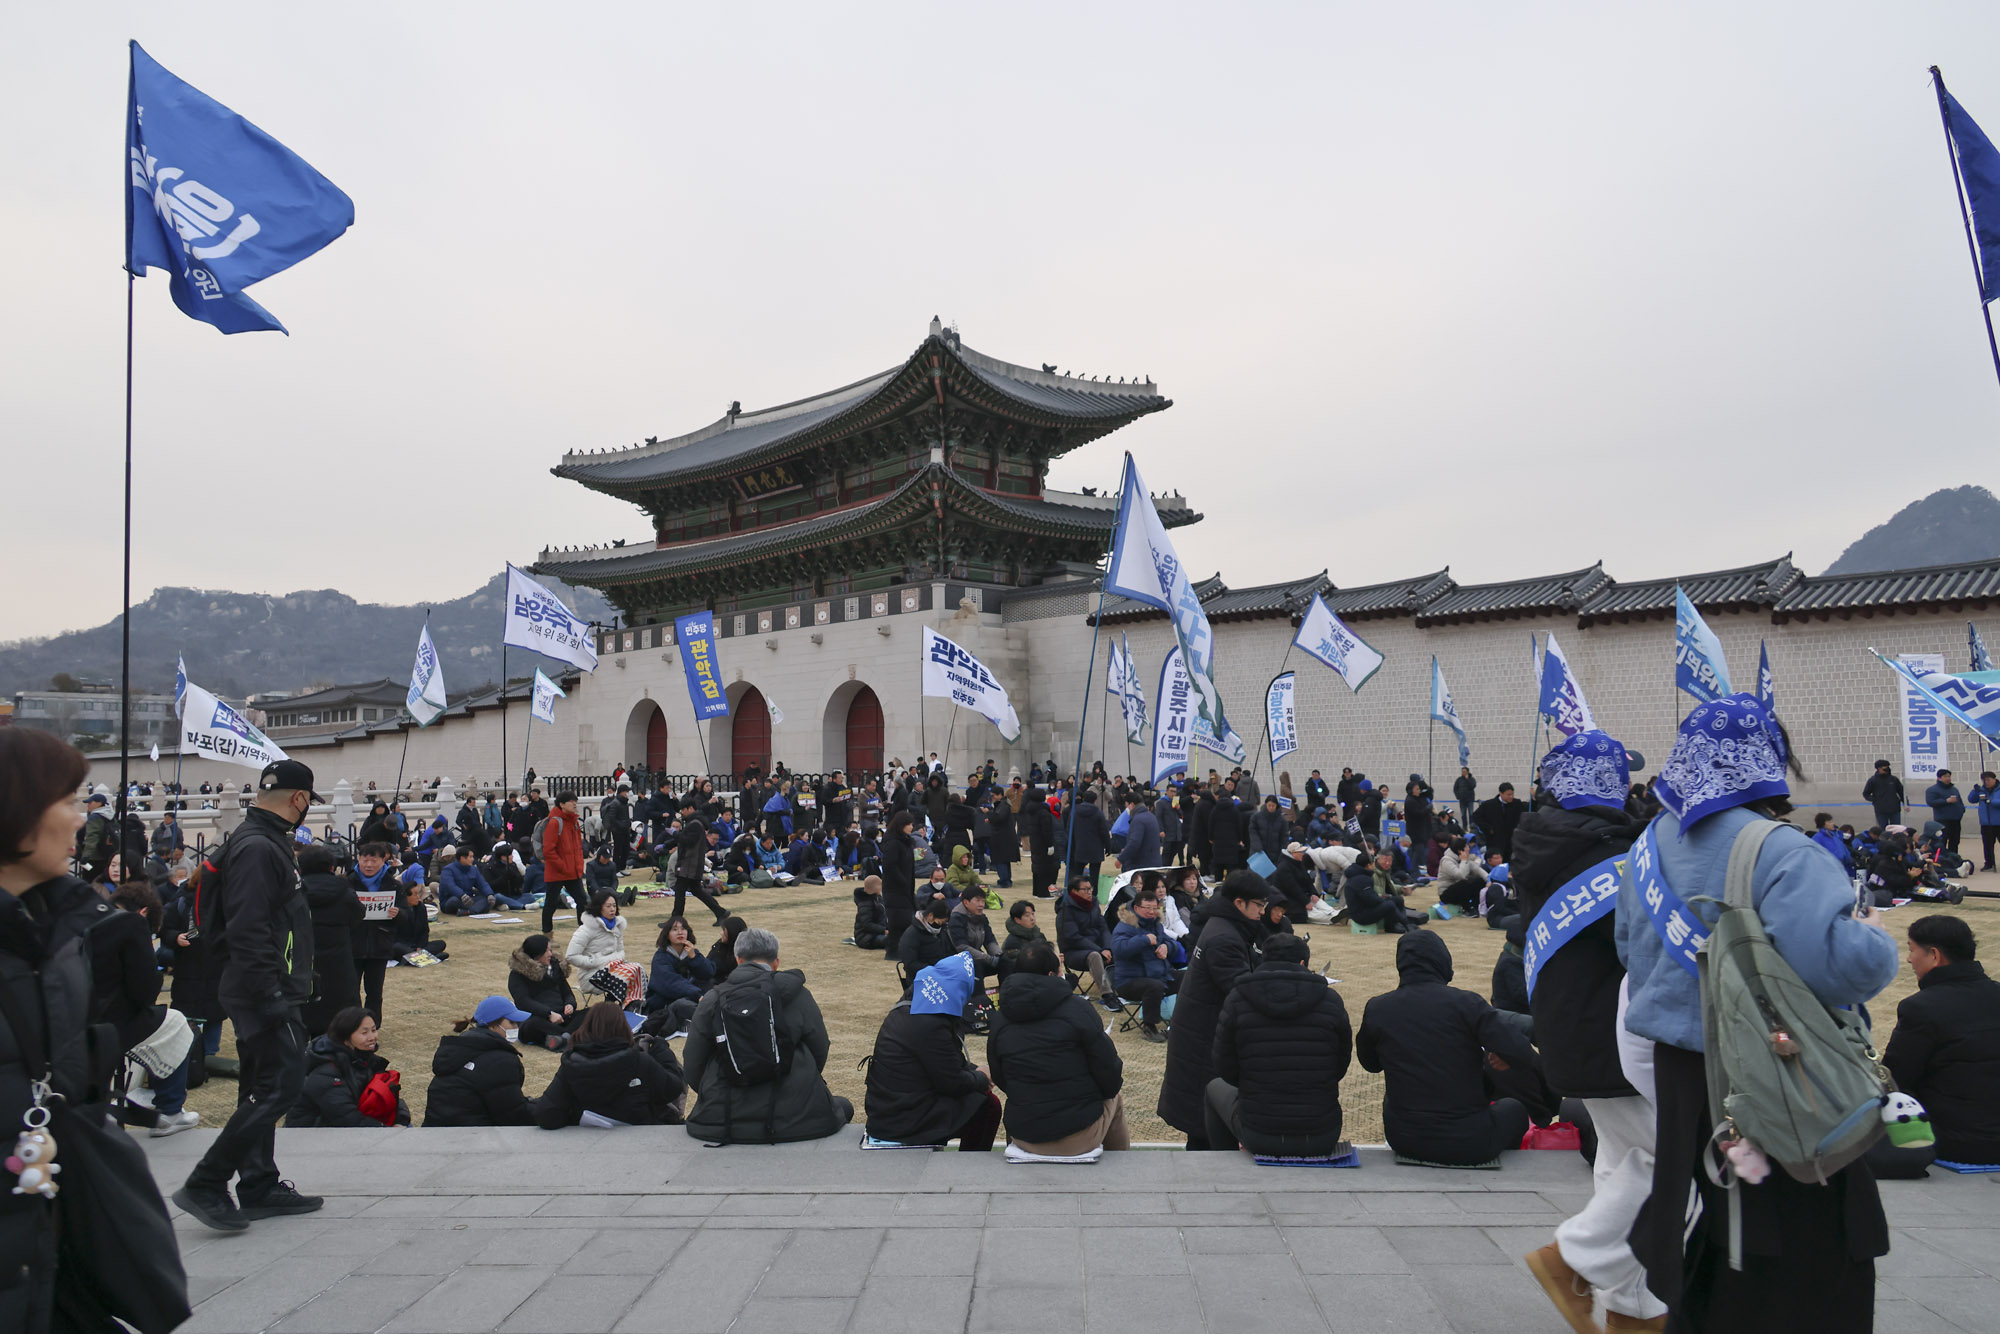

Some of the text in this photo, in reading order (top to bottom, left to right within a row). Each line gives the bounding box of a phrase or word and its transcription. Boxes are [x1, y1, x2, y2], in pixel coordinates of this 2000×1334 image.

[528, 621, 580, 650] 지역위원회
[685, 623, 707, 636] 민주당
[689, 639, 720, 699] 관악갑
[946, 671, 985, 695] 지역위원회
[1273, 682, 1292, 690] 민주당
[952, 690, 976, 706] 민주당
[1160, 680, 1191, 750] 광주시(갑)
[1286, 707, 1298, 750] 지역위원회
[187, 731, 238, 758] 마포(갑)
[1158, 752, 1187, 760] 지역위원회
[1911, 764, 1937, 773] 민주당
[1645, 878, 1664, 915] 또
[1534, 872, 1620, 950] 여자가 또
